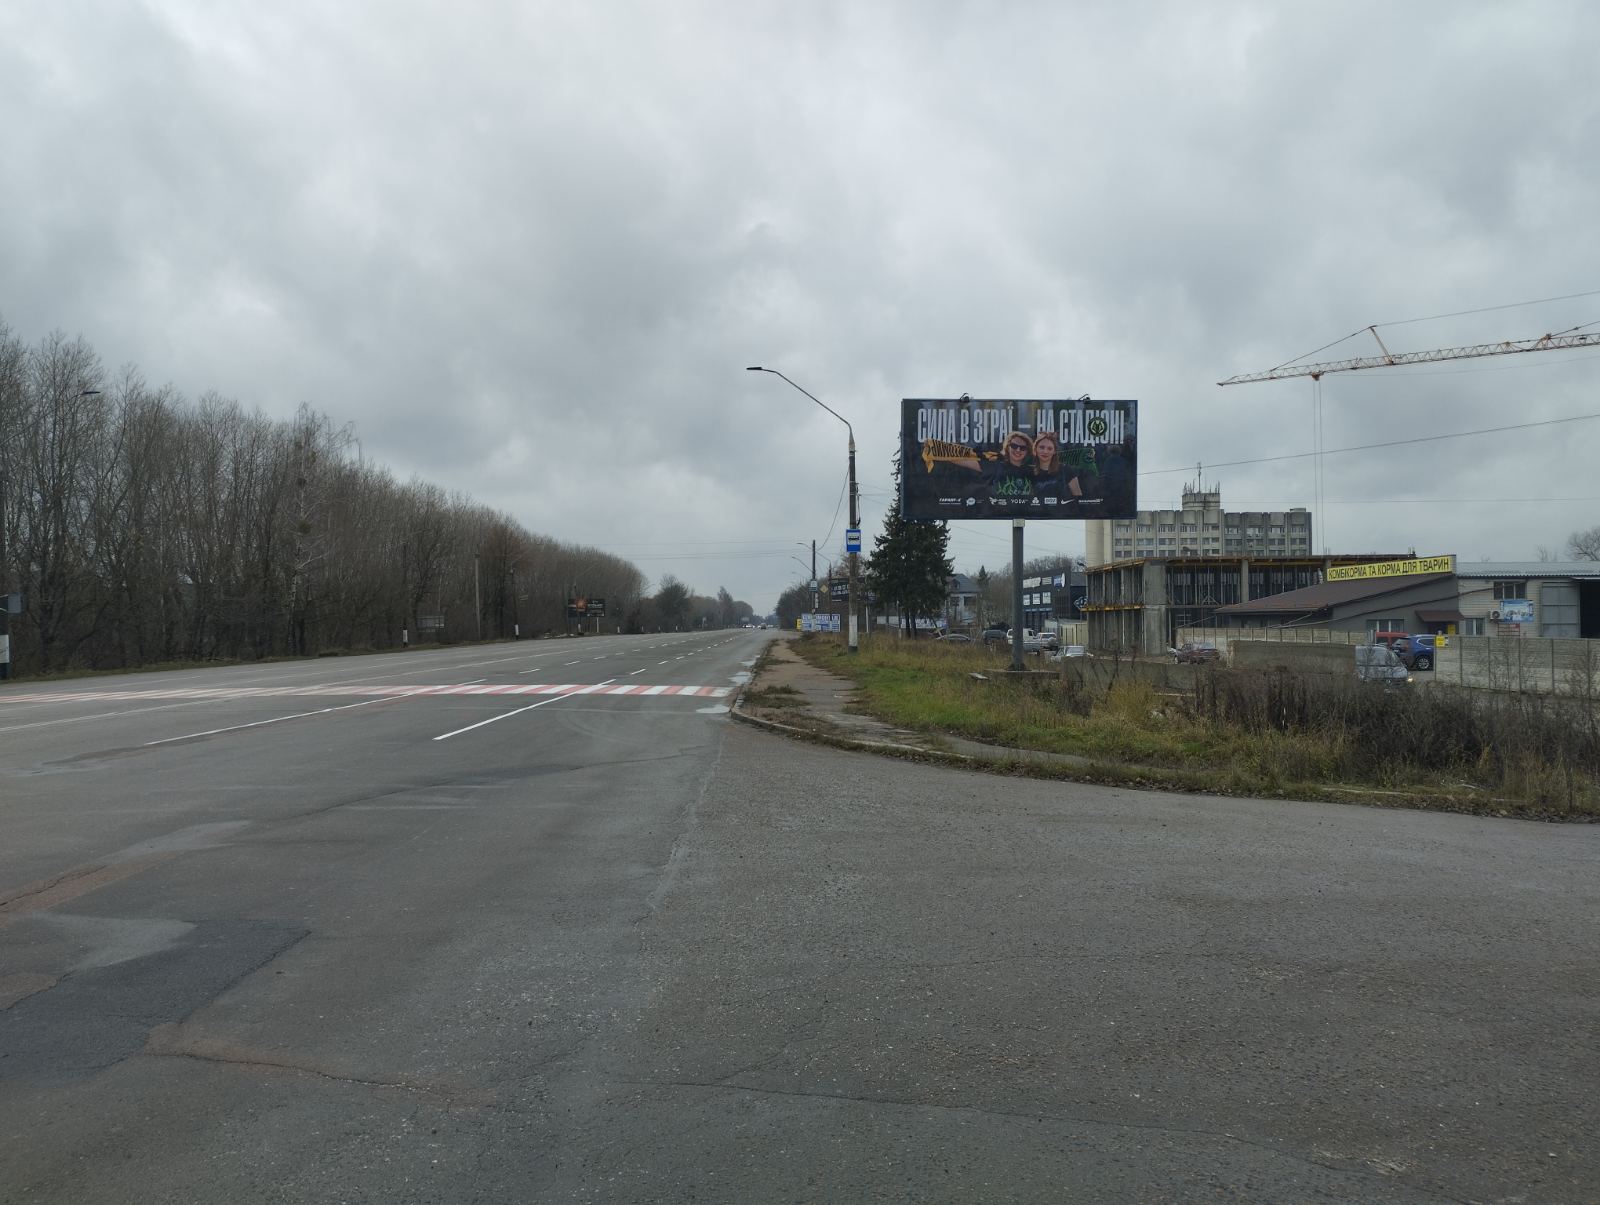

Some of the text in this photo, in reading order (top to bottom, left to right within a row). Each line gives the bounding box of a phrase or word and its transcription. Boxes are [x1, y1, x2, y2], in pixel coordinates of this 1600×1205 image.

[917, 408, 956, 443] СИЛА
[960, 408, 970, 443] В
[973, 406, 1014, 443] ЗГРАЇ
[1036, 408, 1055, 433] НА
[1328, 558, 1449, 580] КОМБІКОРМА ТА КОРМА ДЛЯ ТВАРИН
